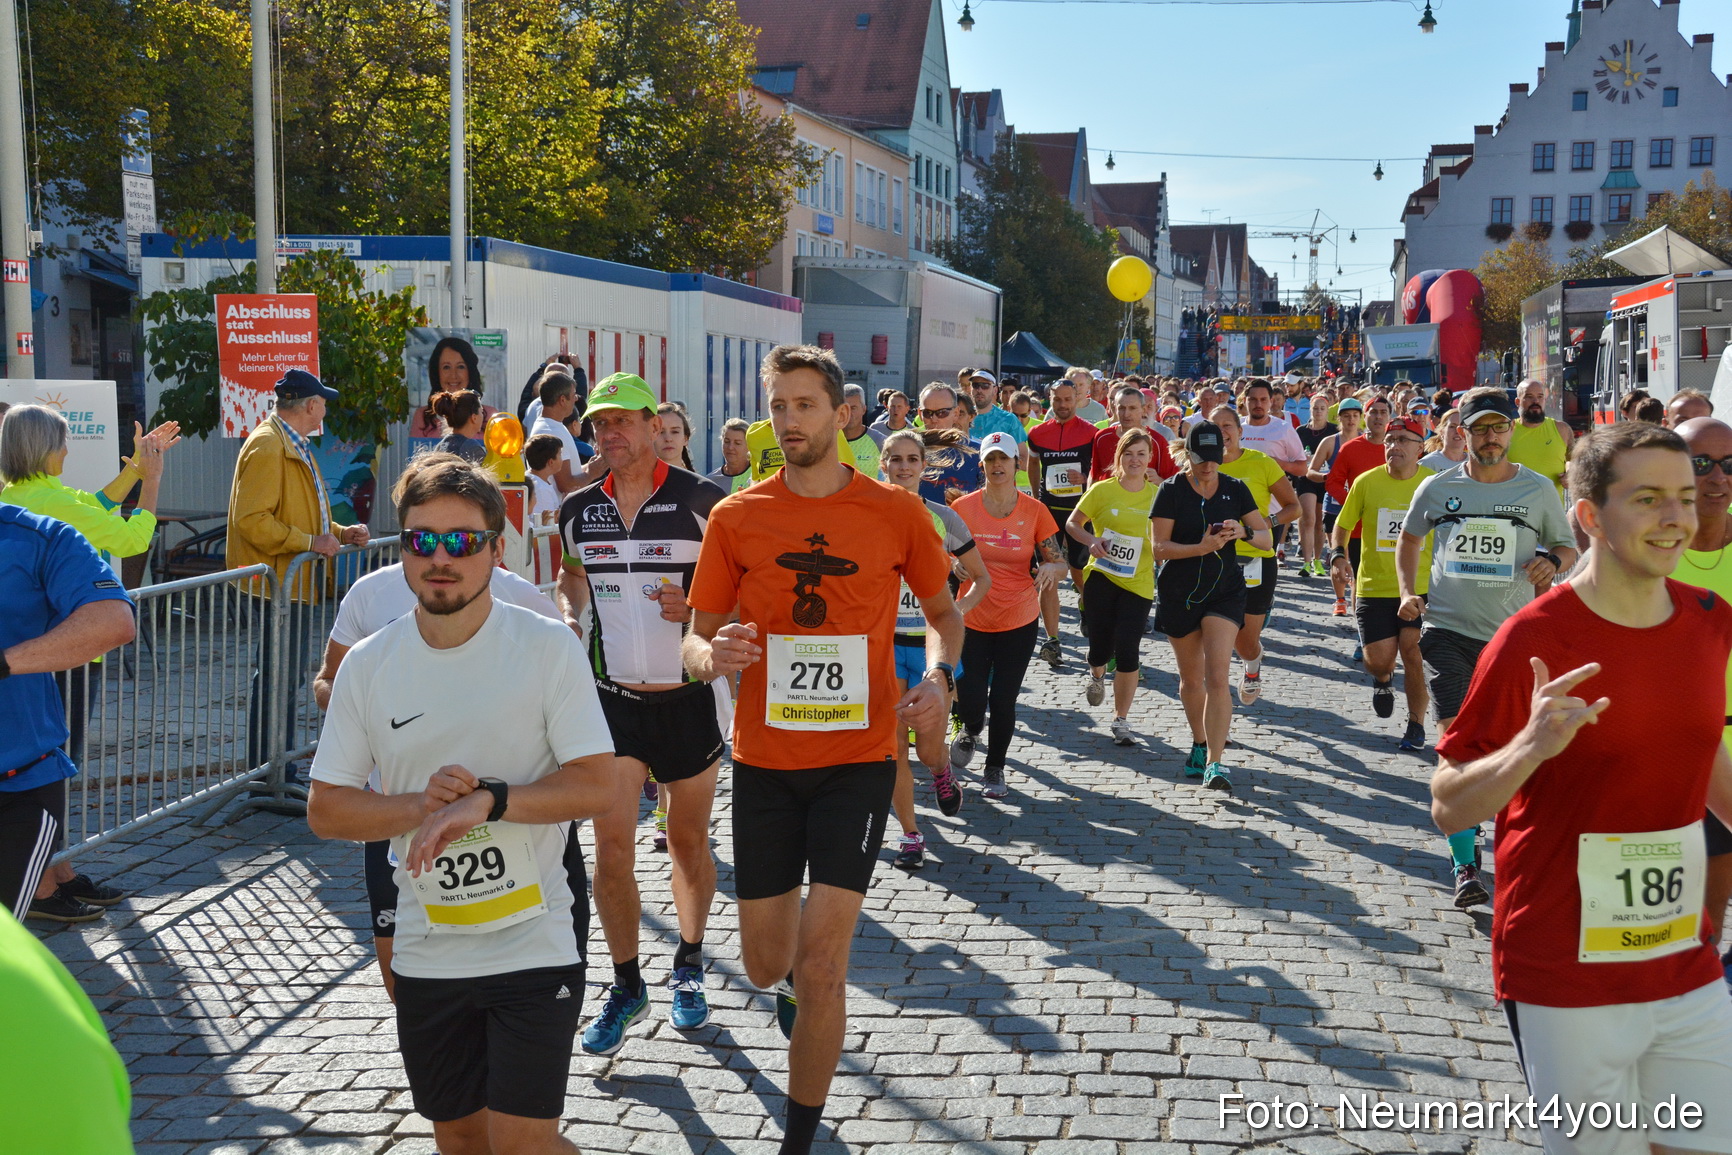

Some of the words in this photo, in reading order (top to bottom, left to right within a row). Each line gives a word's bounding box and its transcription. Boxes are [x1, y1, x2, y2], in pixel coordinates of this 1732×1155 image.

[126, 189, 152, 200] Parkschein
[129, 201, 151, 212] werktags
[3, 262, 26, 281] FCN
[51, 296, 60, 317] 3
[226, 304, 311, 319] Abschluss
[226, 320, 254, 329] statt
[1252, 318, 1288, 328] START
[227, 331, 312, 344] Ausschluss!
[243, 353, 266, 361] Mehr
[268, 353, 296, 362] Lehrer
[297, 352, 309, 361] für
[239, 364, 274, 372] kleinere
[992, 434, 1001, 444] B
[1054, 473, 1070, 483] 16
[1494, 505, 1529, 515] BOCK
[1389, 522, 1403, 534] 29
[639, 547, 671, 555] ROCK
[1455, 535, 1505, 555] 2159
[1108, 544, 1135, 561] 550
[1460, 564, 1497, 574] Matthias
[795, 643, 839, 654] BOCK
[790, 662, 843, 691] 278
[783, 707, 851, 722] Christopher
[1621, 842, 1682, 856] BOCK
[435, 846, 506, 890] 329
[467, 885, 504, 899] Neumarkt
[1615, 866, 1684, 907] 186
[1643, 909, 1674, 920] Neumarkt
[1621, 924, 1671, 947] Samuel
